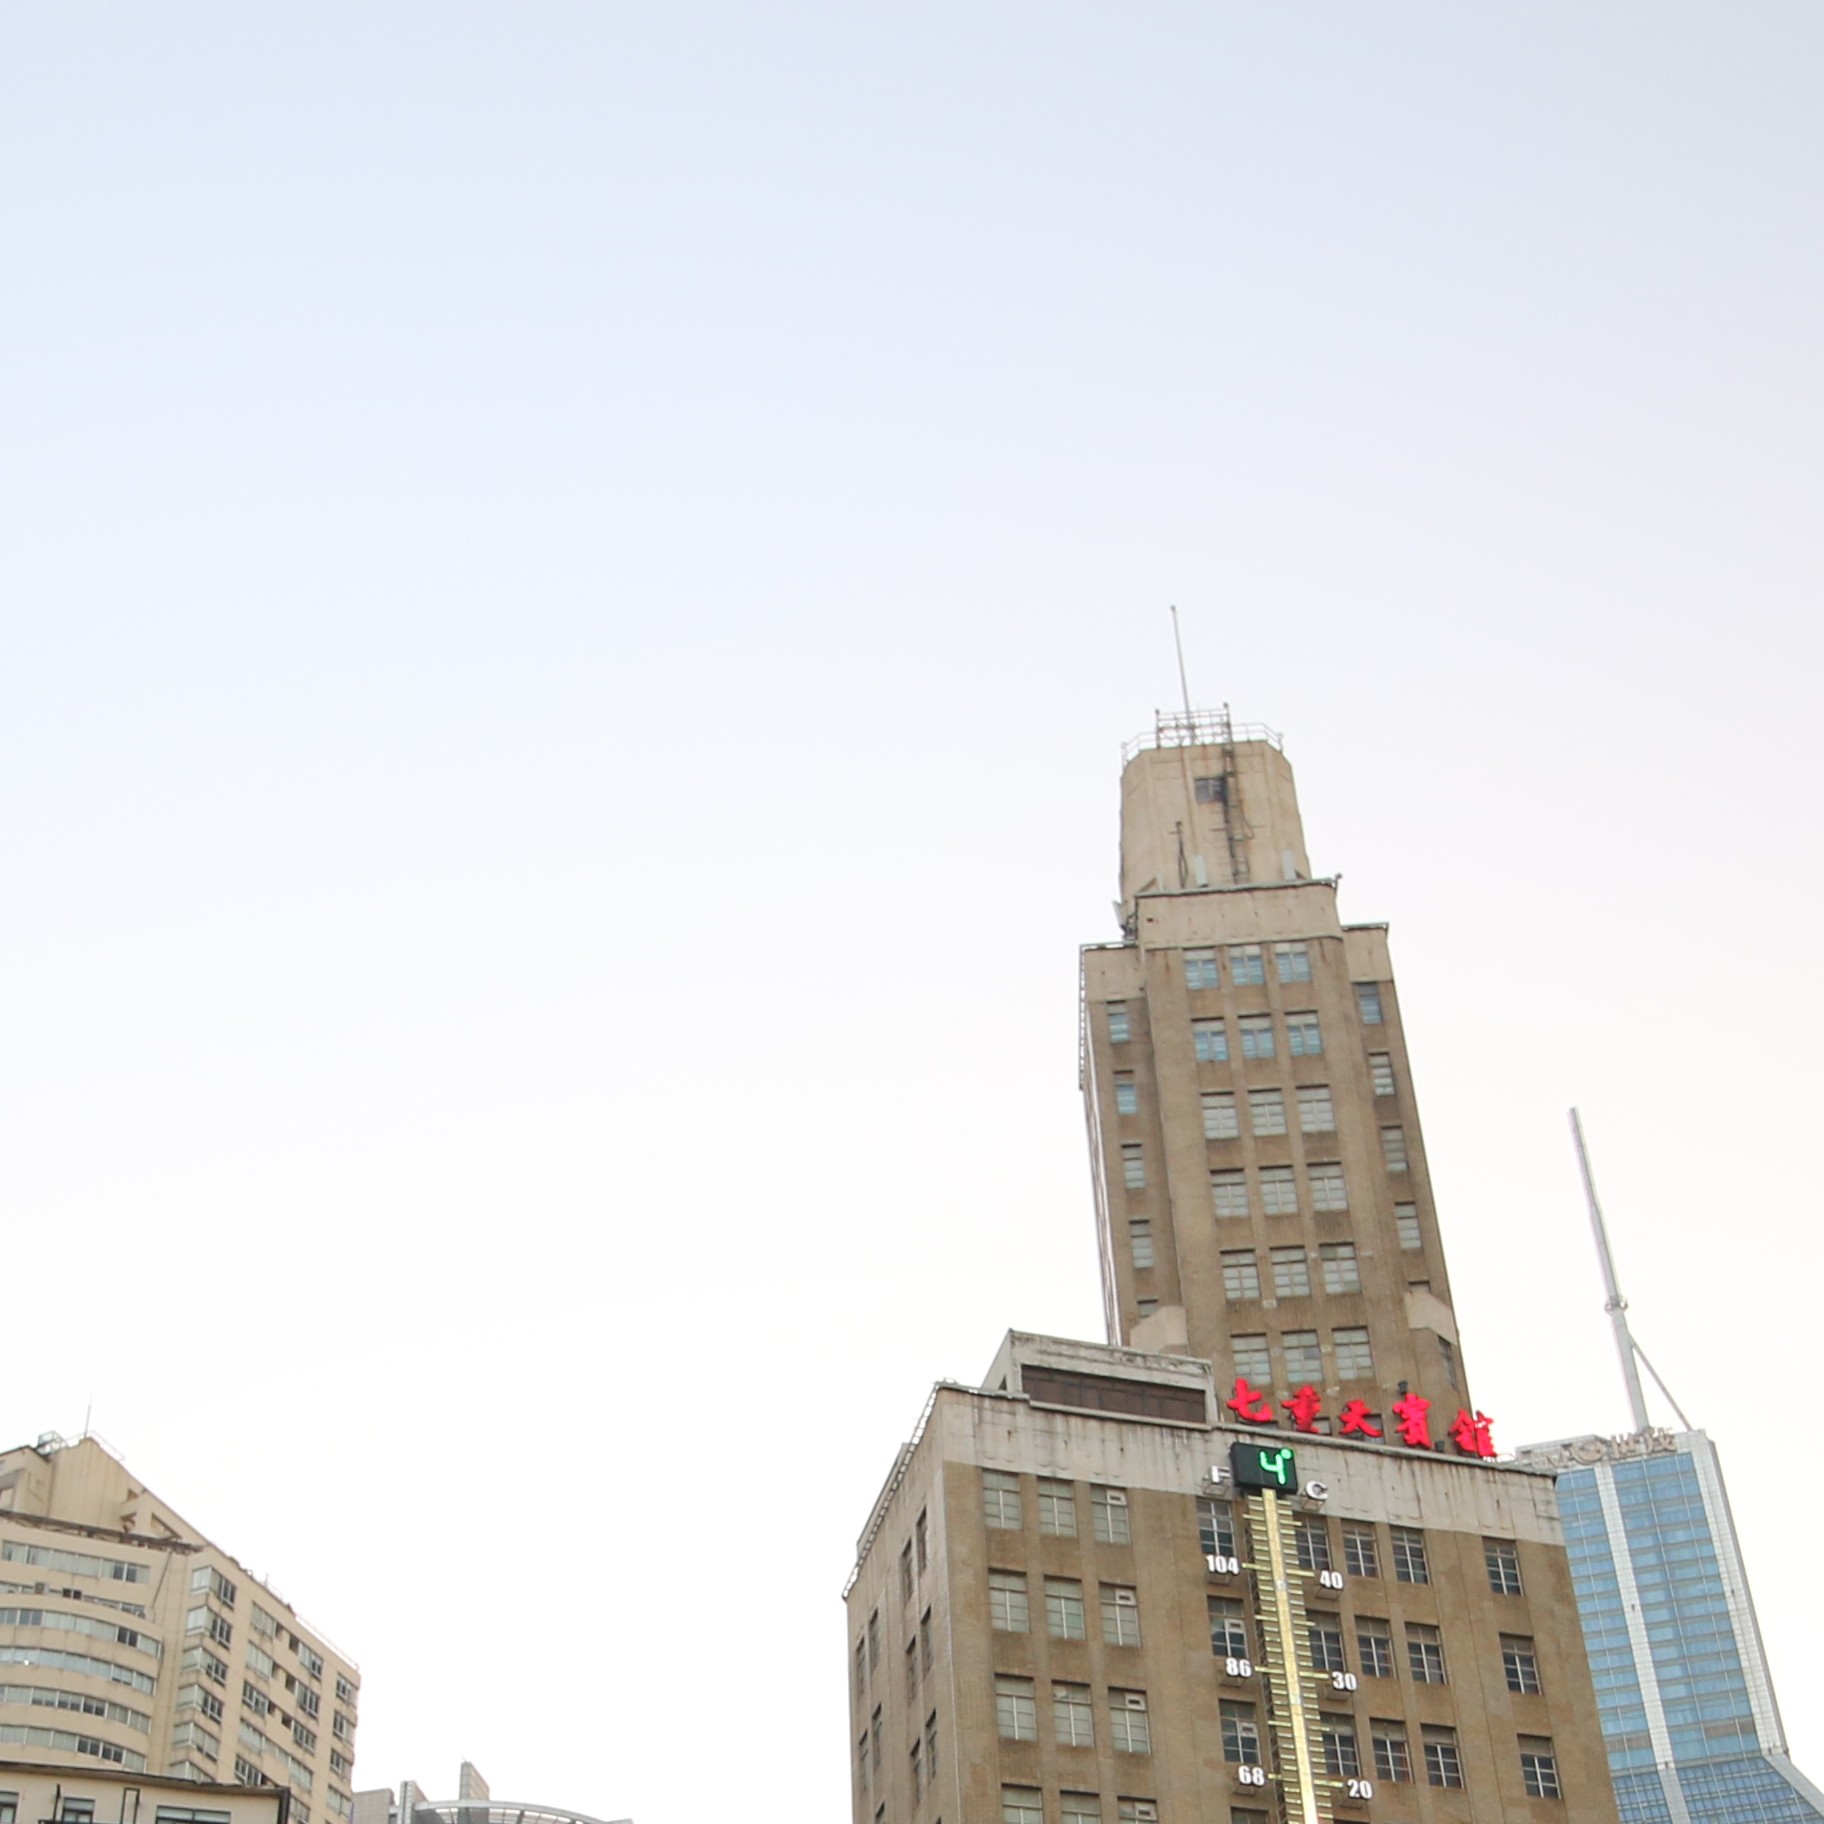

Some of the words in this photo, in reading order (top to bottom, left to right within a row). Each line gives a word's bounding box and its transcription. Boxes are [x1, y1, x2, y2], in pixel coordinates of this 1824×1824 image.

[1206, 1554, 1240, 1576] 104
[1319, 1570, 1344, 1590] 40
[1225, 1657, 1252, 1678] 86
[1331, 1671, 1358, 1691] 30
[1238, 1765, 1265, 1786] 68
[1347, 1778, 1373, 1800] 20
